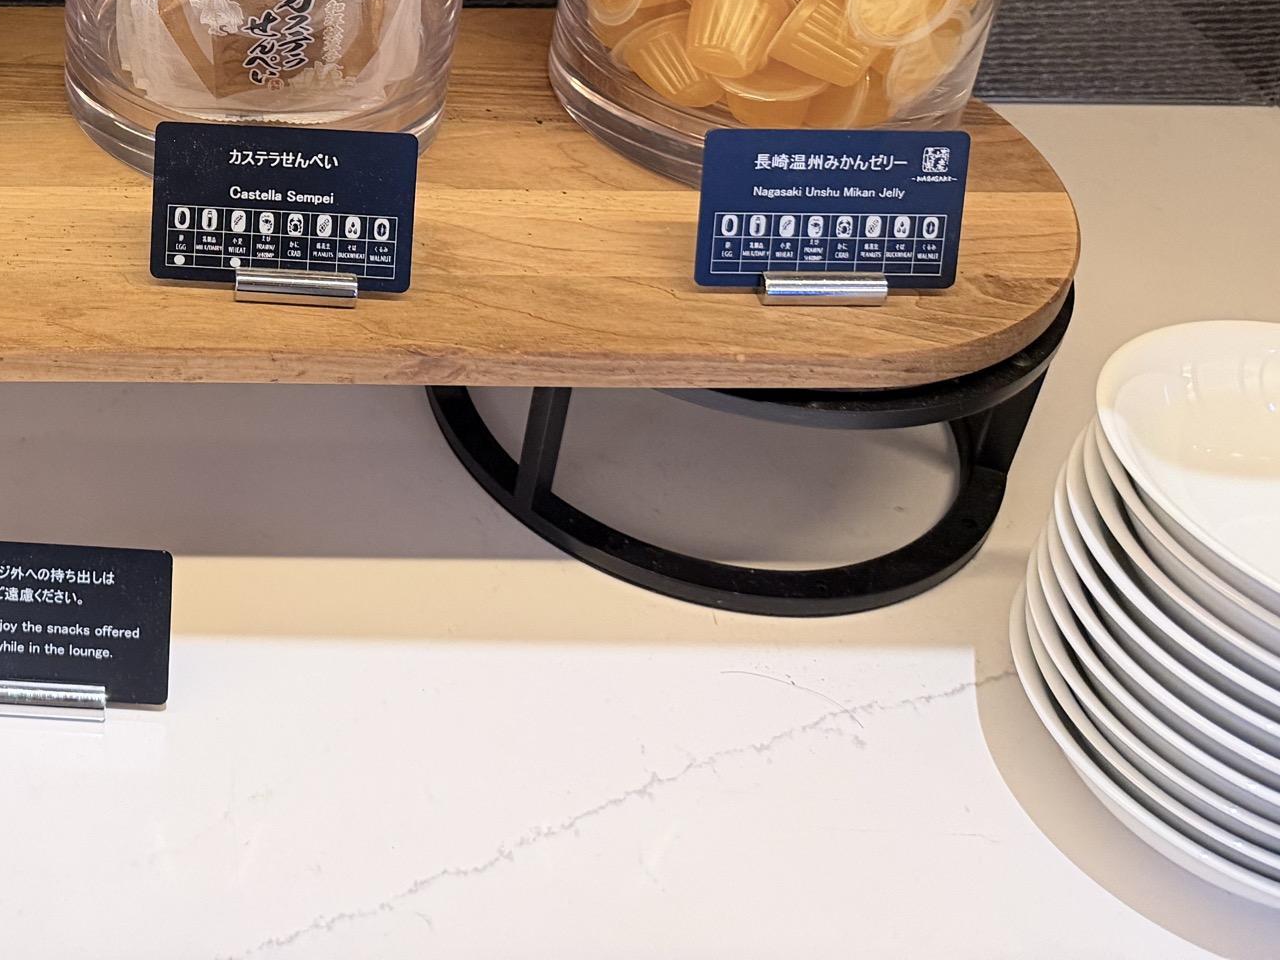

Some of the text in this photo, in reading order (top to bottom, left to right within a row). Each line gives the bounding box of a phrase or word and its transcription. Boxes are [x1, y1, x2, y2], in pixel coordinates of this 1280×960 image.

[228, 149, 339, 169] カステラせんぺい
[754, 153, 908, 171] 長崎温州みかんゼリー
[229, 186, 334, 204] Castella Sempei
[753, 186, 905, 200] Nagasaki Unshu Mikan Jelly
[22, 620, 42, 633] the
[47, 623, 90, 636] snacks
[95, 625, 140, 639] offered
[29, 642, 40, 654] in
[44, 644, 65, 655] the
[69, 645, 113, 659] lounge.
